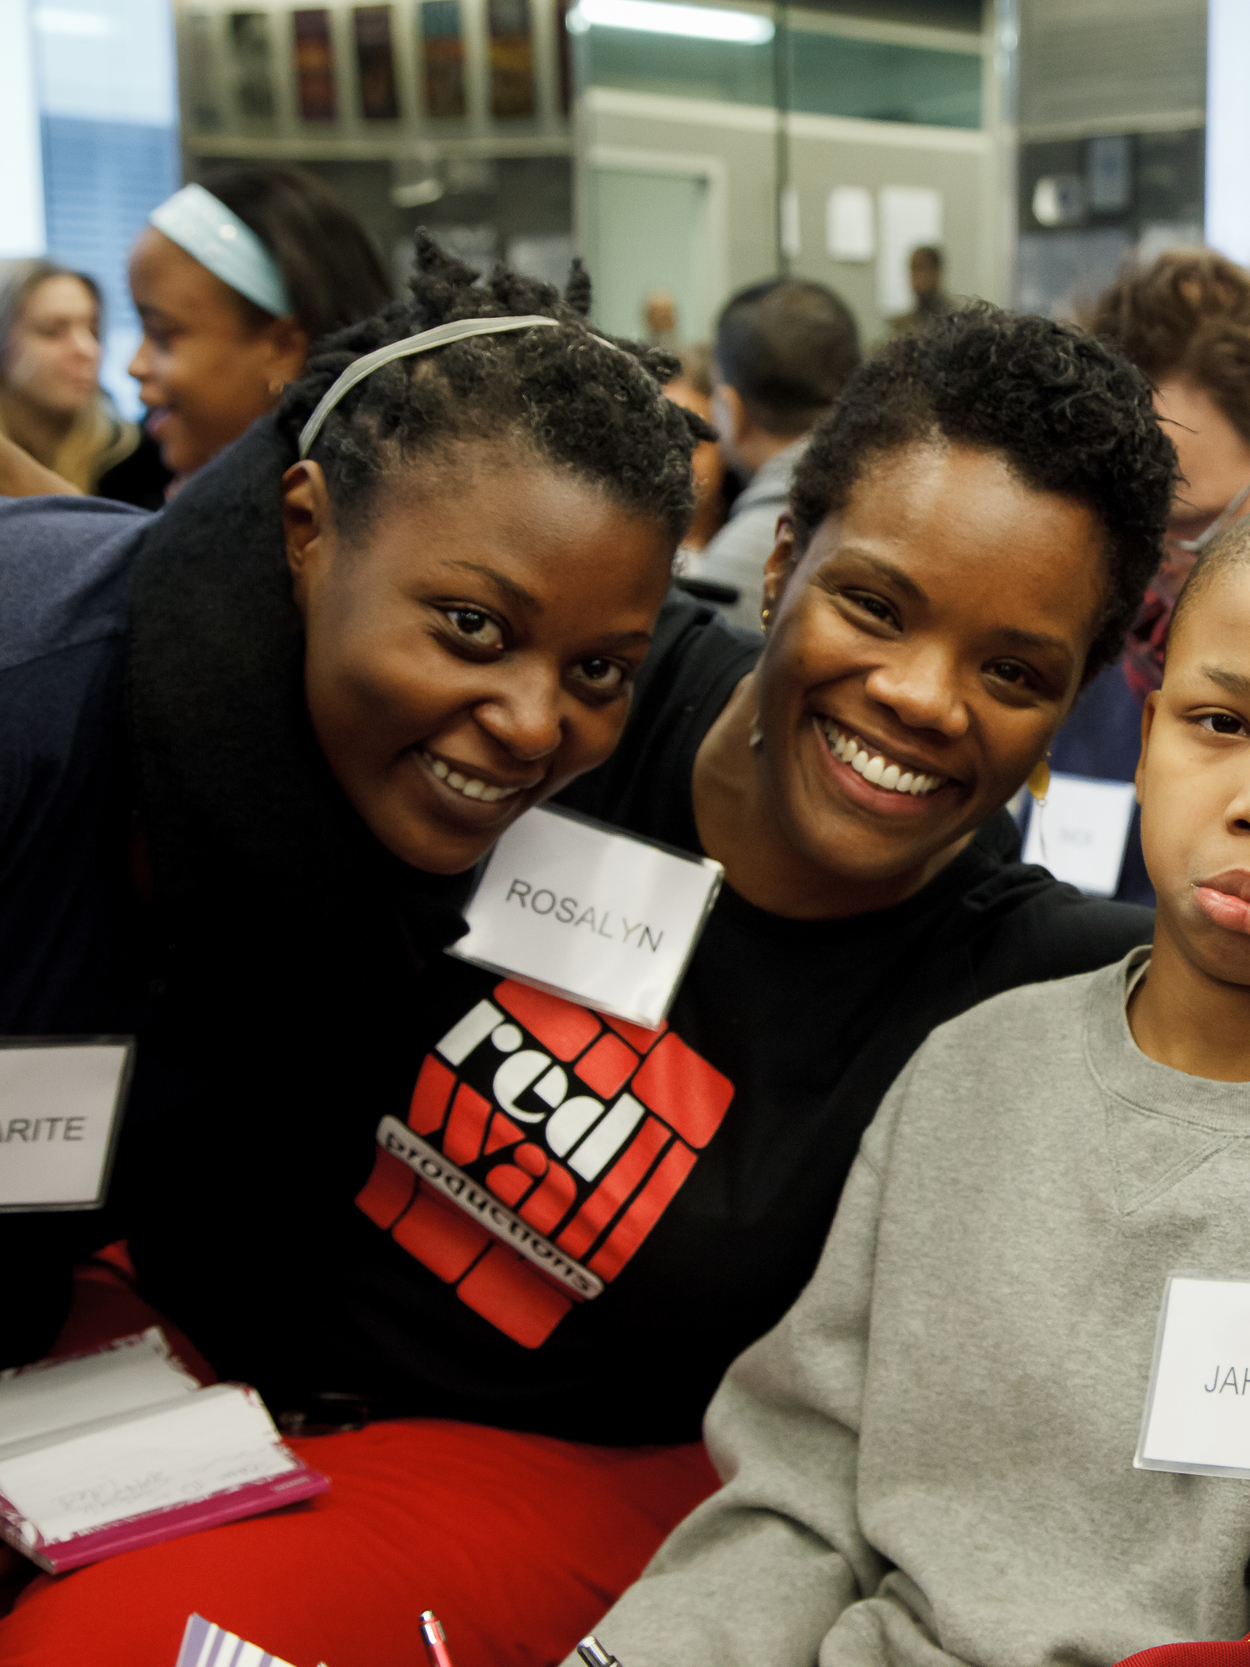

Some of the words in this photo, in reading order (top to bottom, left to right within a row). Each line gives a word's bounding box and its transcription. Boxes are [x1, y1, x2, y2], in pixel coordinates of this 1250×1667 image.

[505, 878, 664, 954] ROSALYN
[0, 1115, 87, 1143] RITE
[434, 998, 646, 1183] red
[385, 1130, 592, 1294] productions
